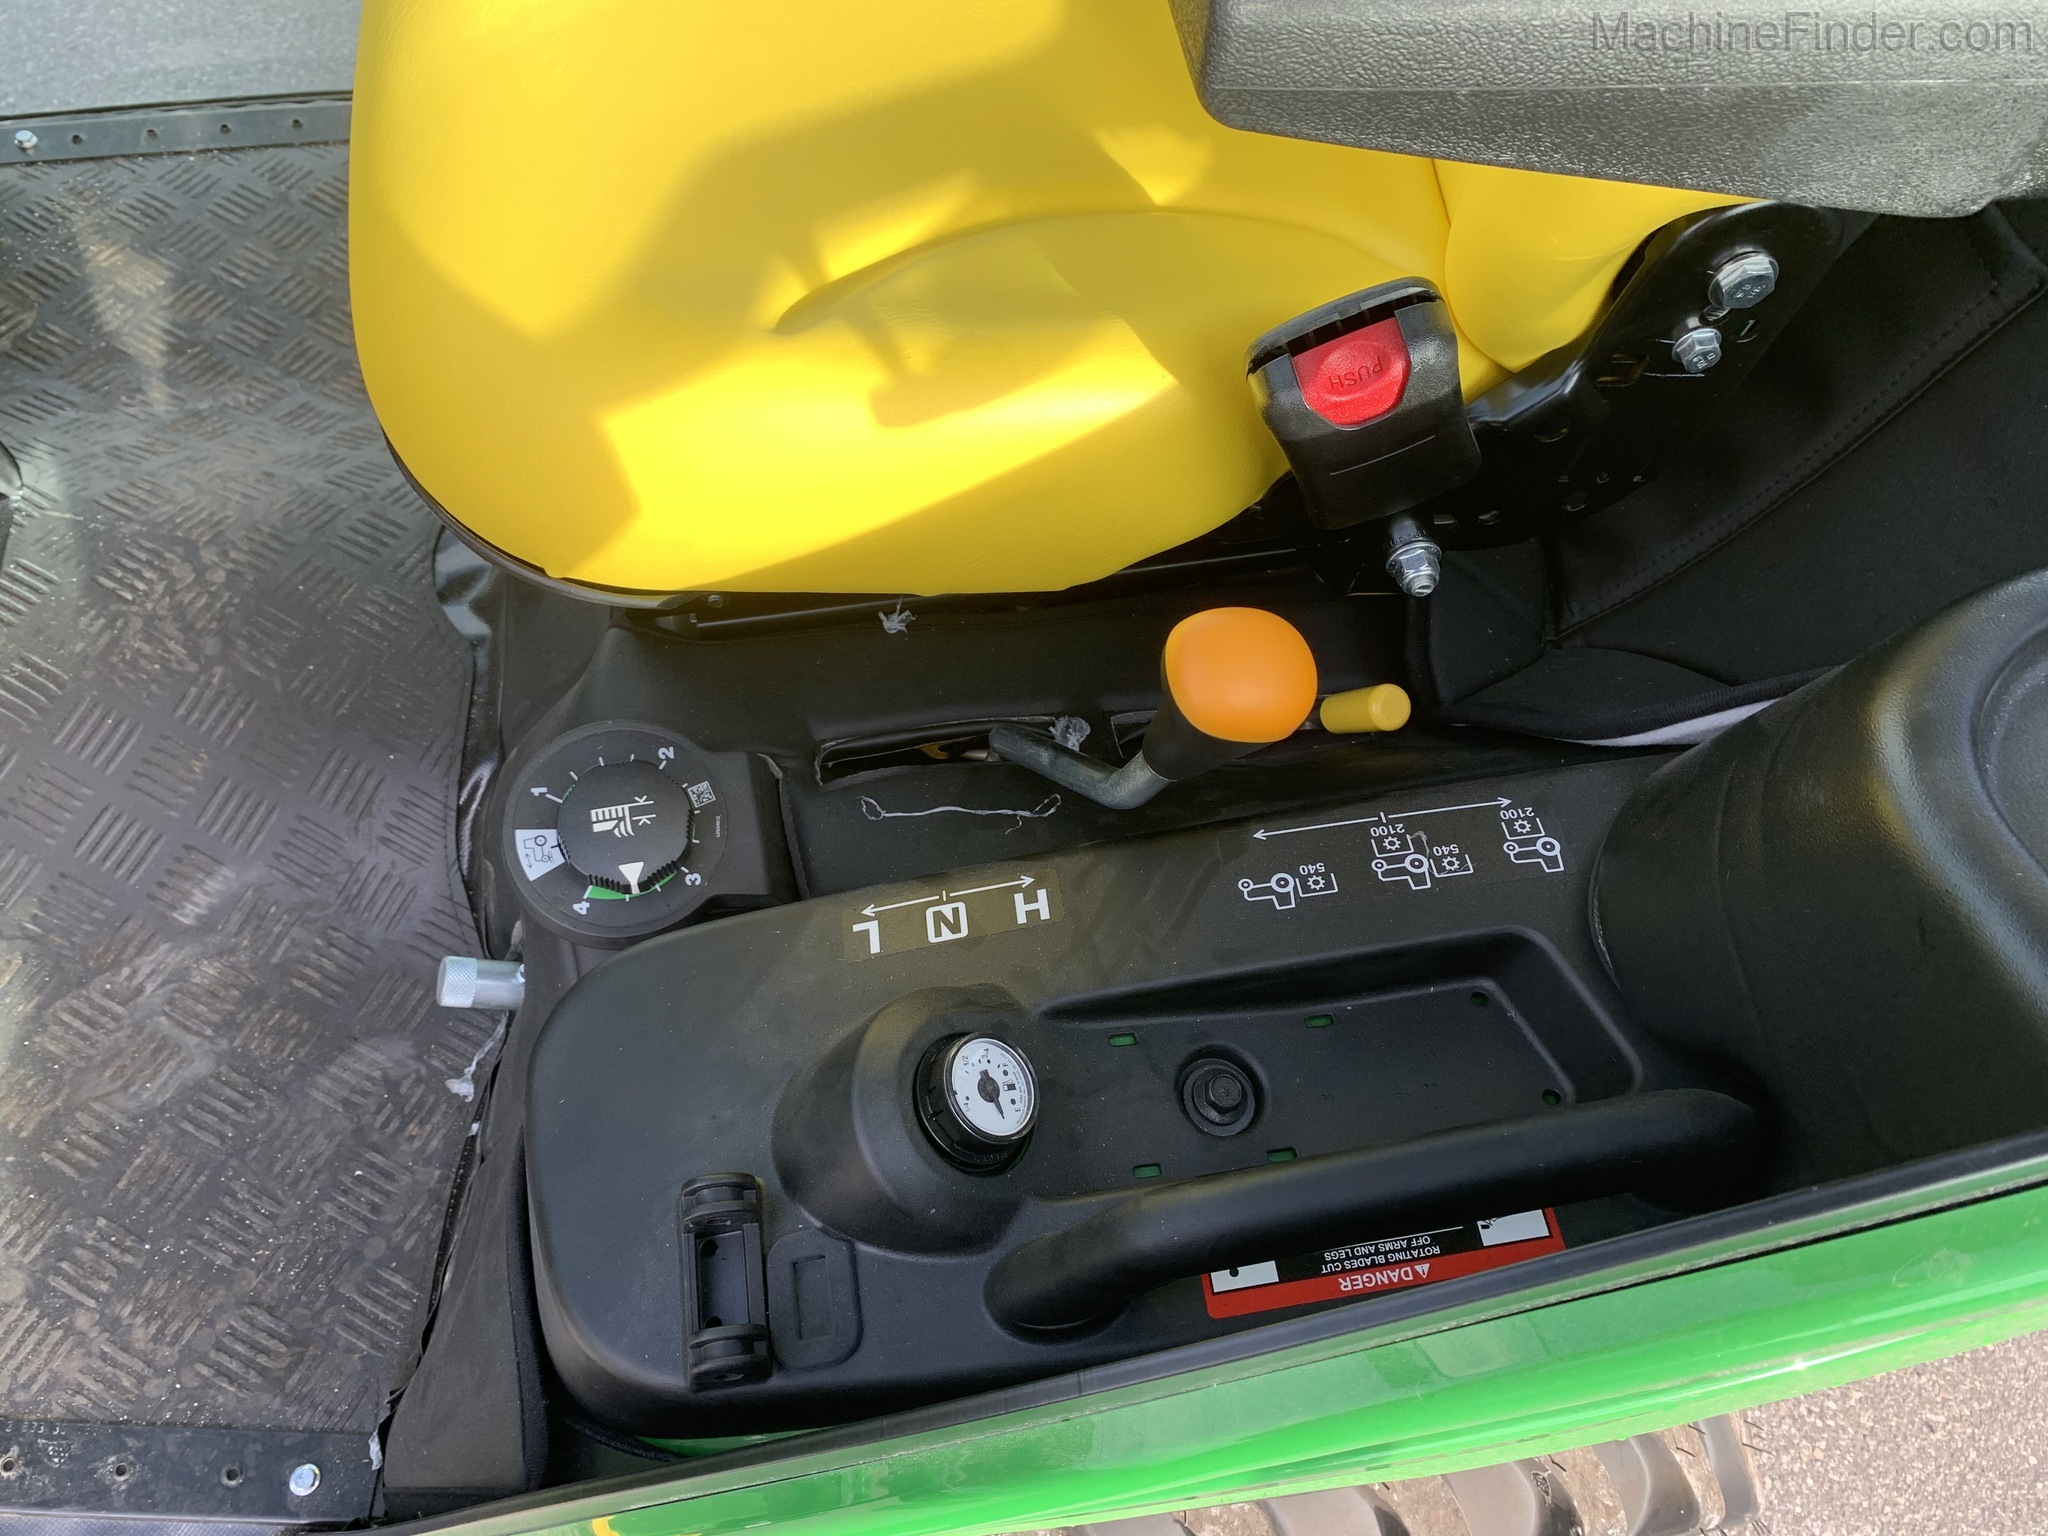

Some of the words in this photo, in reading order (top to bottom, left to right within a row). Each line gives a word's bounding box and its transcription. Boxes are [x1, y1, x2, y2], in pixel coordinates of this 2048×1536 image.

[1327, 356, 1384, 390] PUSH
[657, 745, 675, 760] 2
[529, 786, 548, 797] 1
[1498, 805, 1536, 822] 2100
[1369, 822, 1406, 839] 2100
[1431, 842, 1461, 858] 540
[1298, 861, 1327, 876] 540
[684, 872, 702, 886] 3
[572, 901, 591, 915] 4
[1013, 888, 1051, 924] H
[852, 920, 882, 953] L
[962, 1055, 970, 1066] 1/2
[1377, 1238, 1408, 1253] ARMS
[1409, 1235, 1432, 1249] OFF
[1323, 1247, 1352, 1261] LEGS
[1352, 1243, 1377, 1257] AND
[1386, 1245, 1441, 1264] ROTATING
[1320, 1260, 1342, 1274] CUT
[1343, 1253, 1386, 1270] BLADES
[1338, 1266, 1413, 1292] DANGER
